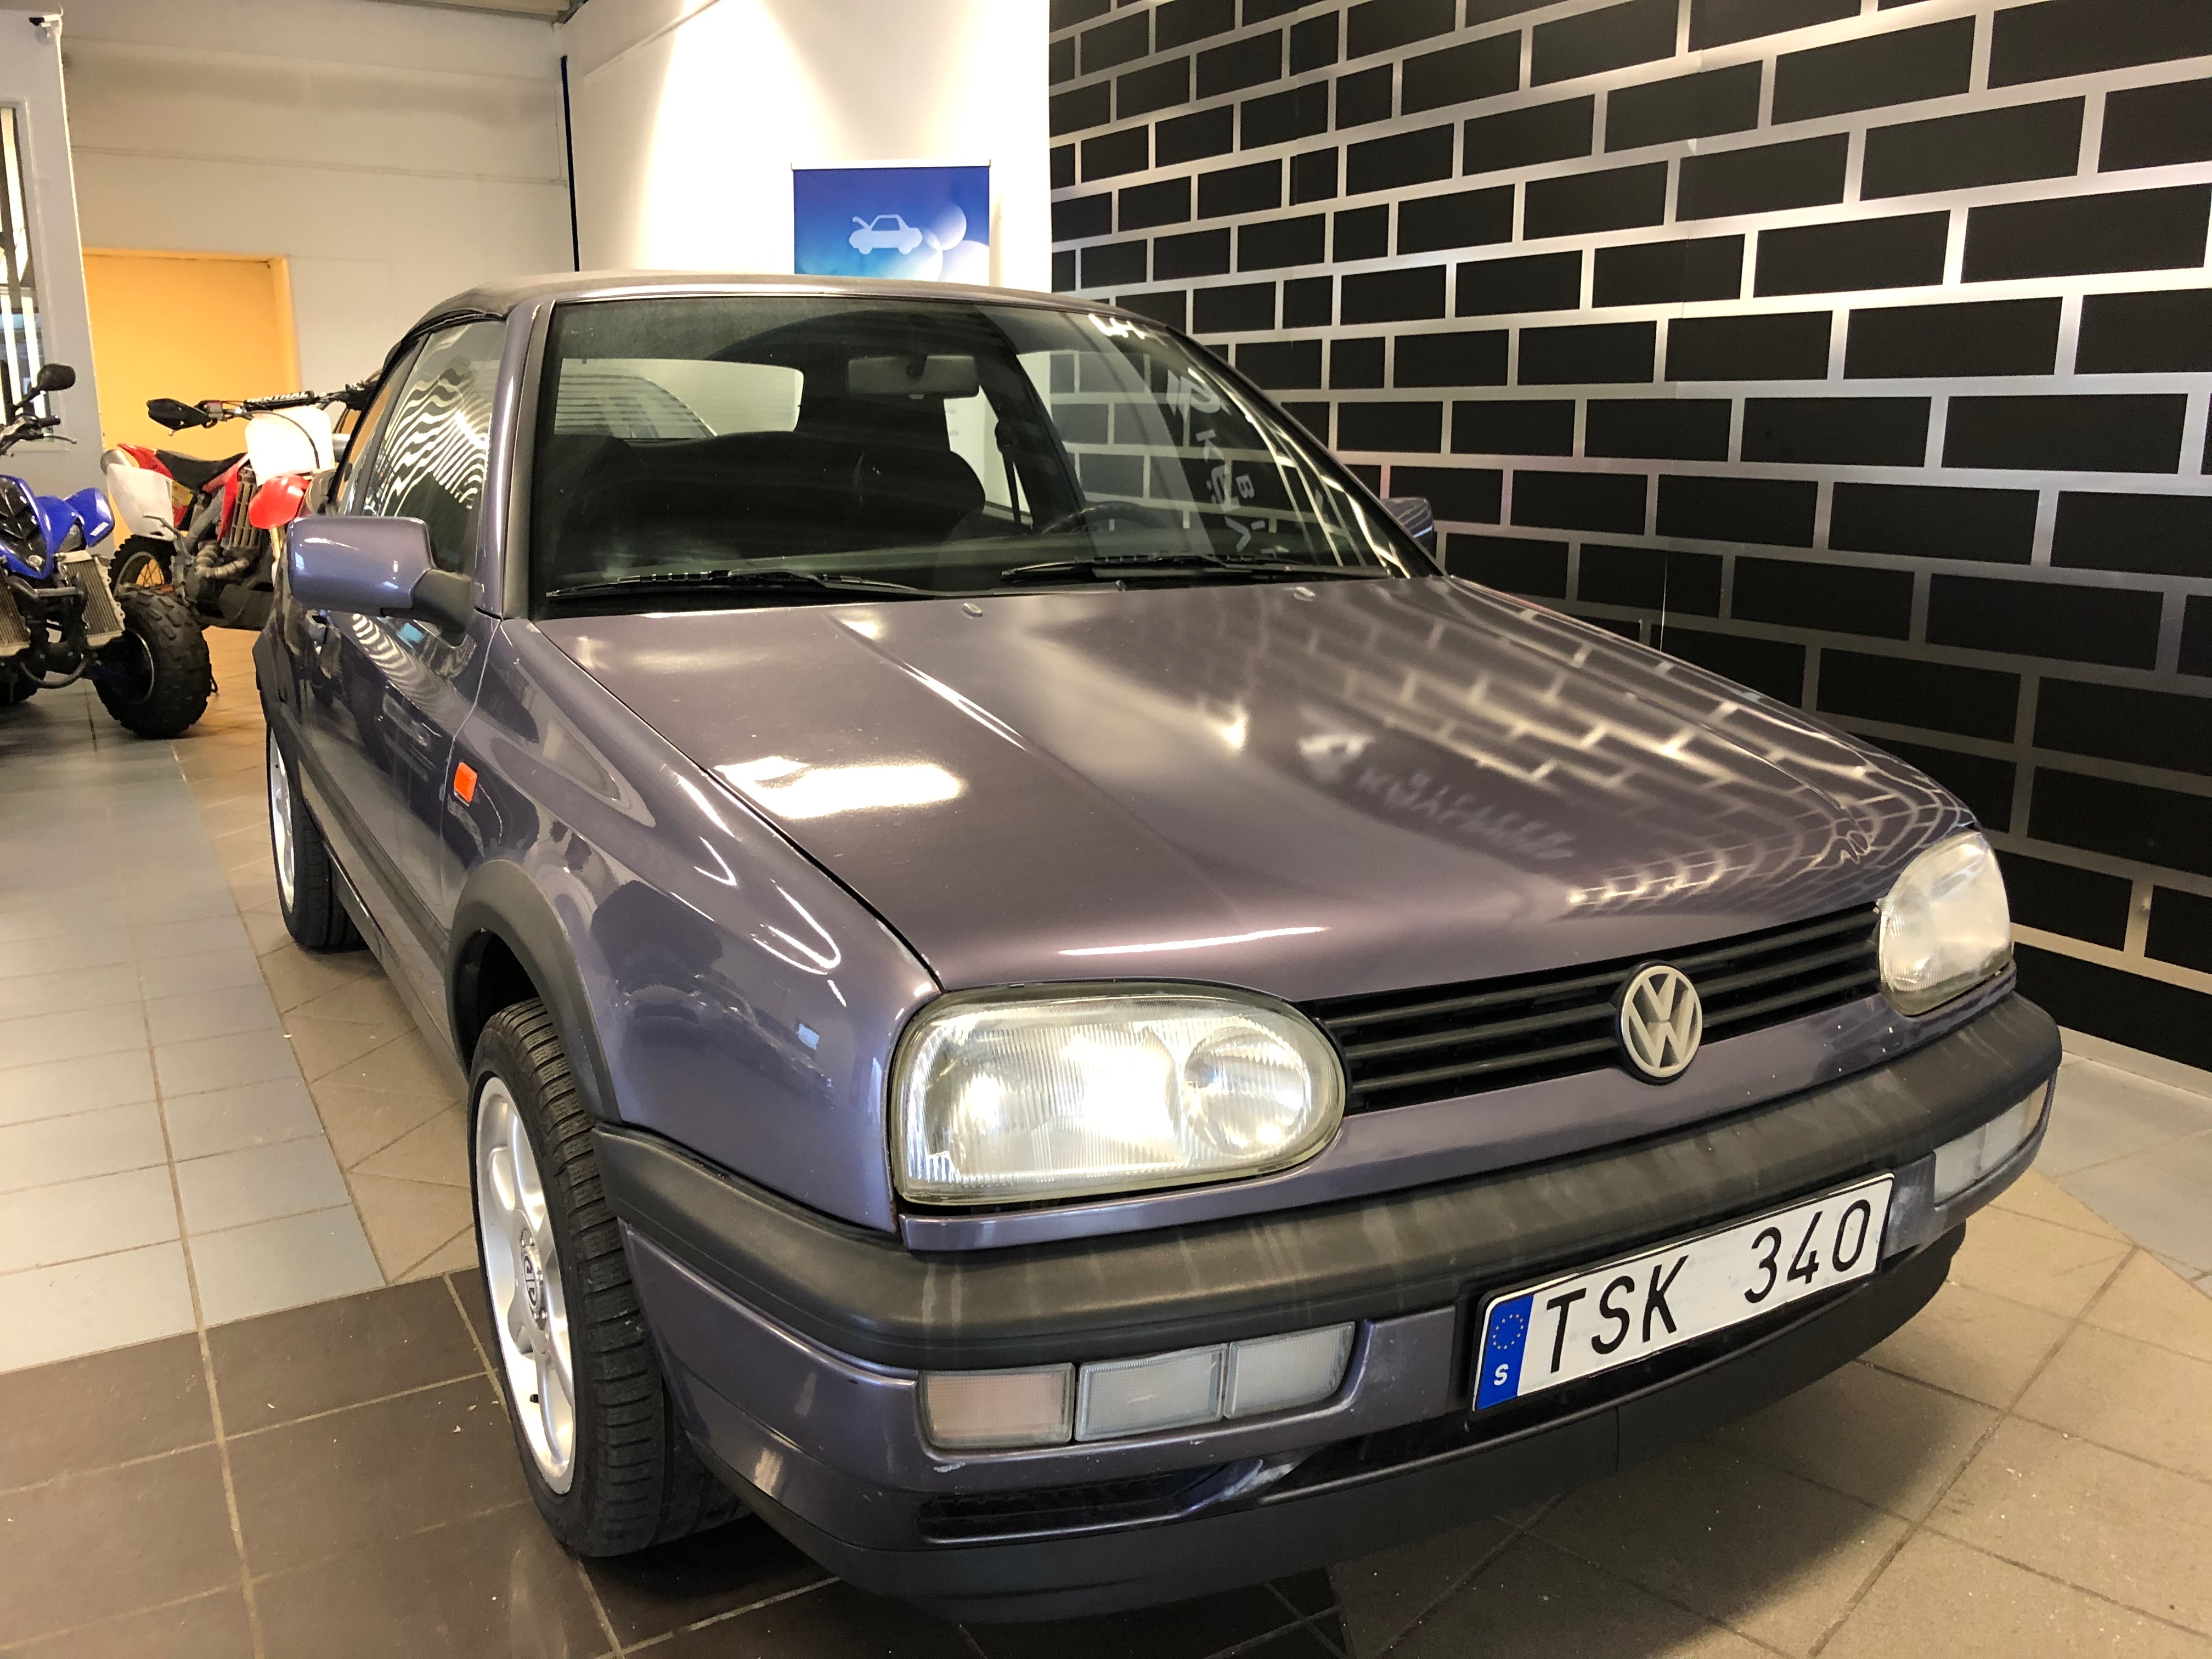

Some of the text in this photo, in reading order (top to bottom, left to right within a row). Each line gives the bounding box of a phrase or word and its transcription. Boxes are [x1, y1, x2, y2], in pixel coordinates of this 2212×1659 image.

[1621, 965, 1703, 1077] VW
[1546, 1199, 1871, 1374] TSK 340
[1493, 1363, 1509, 1386] S
